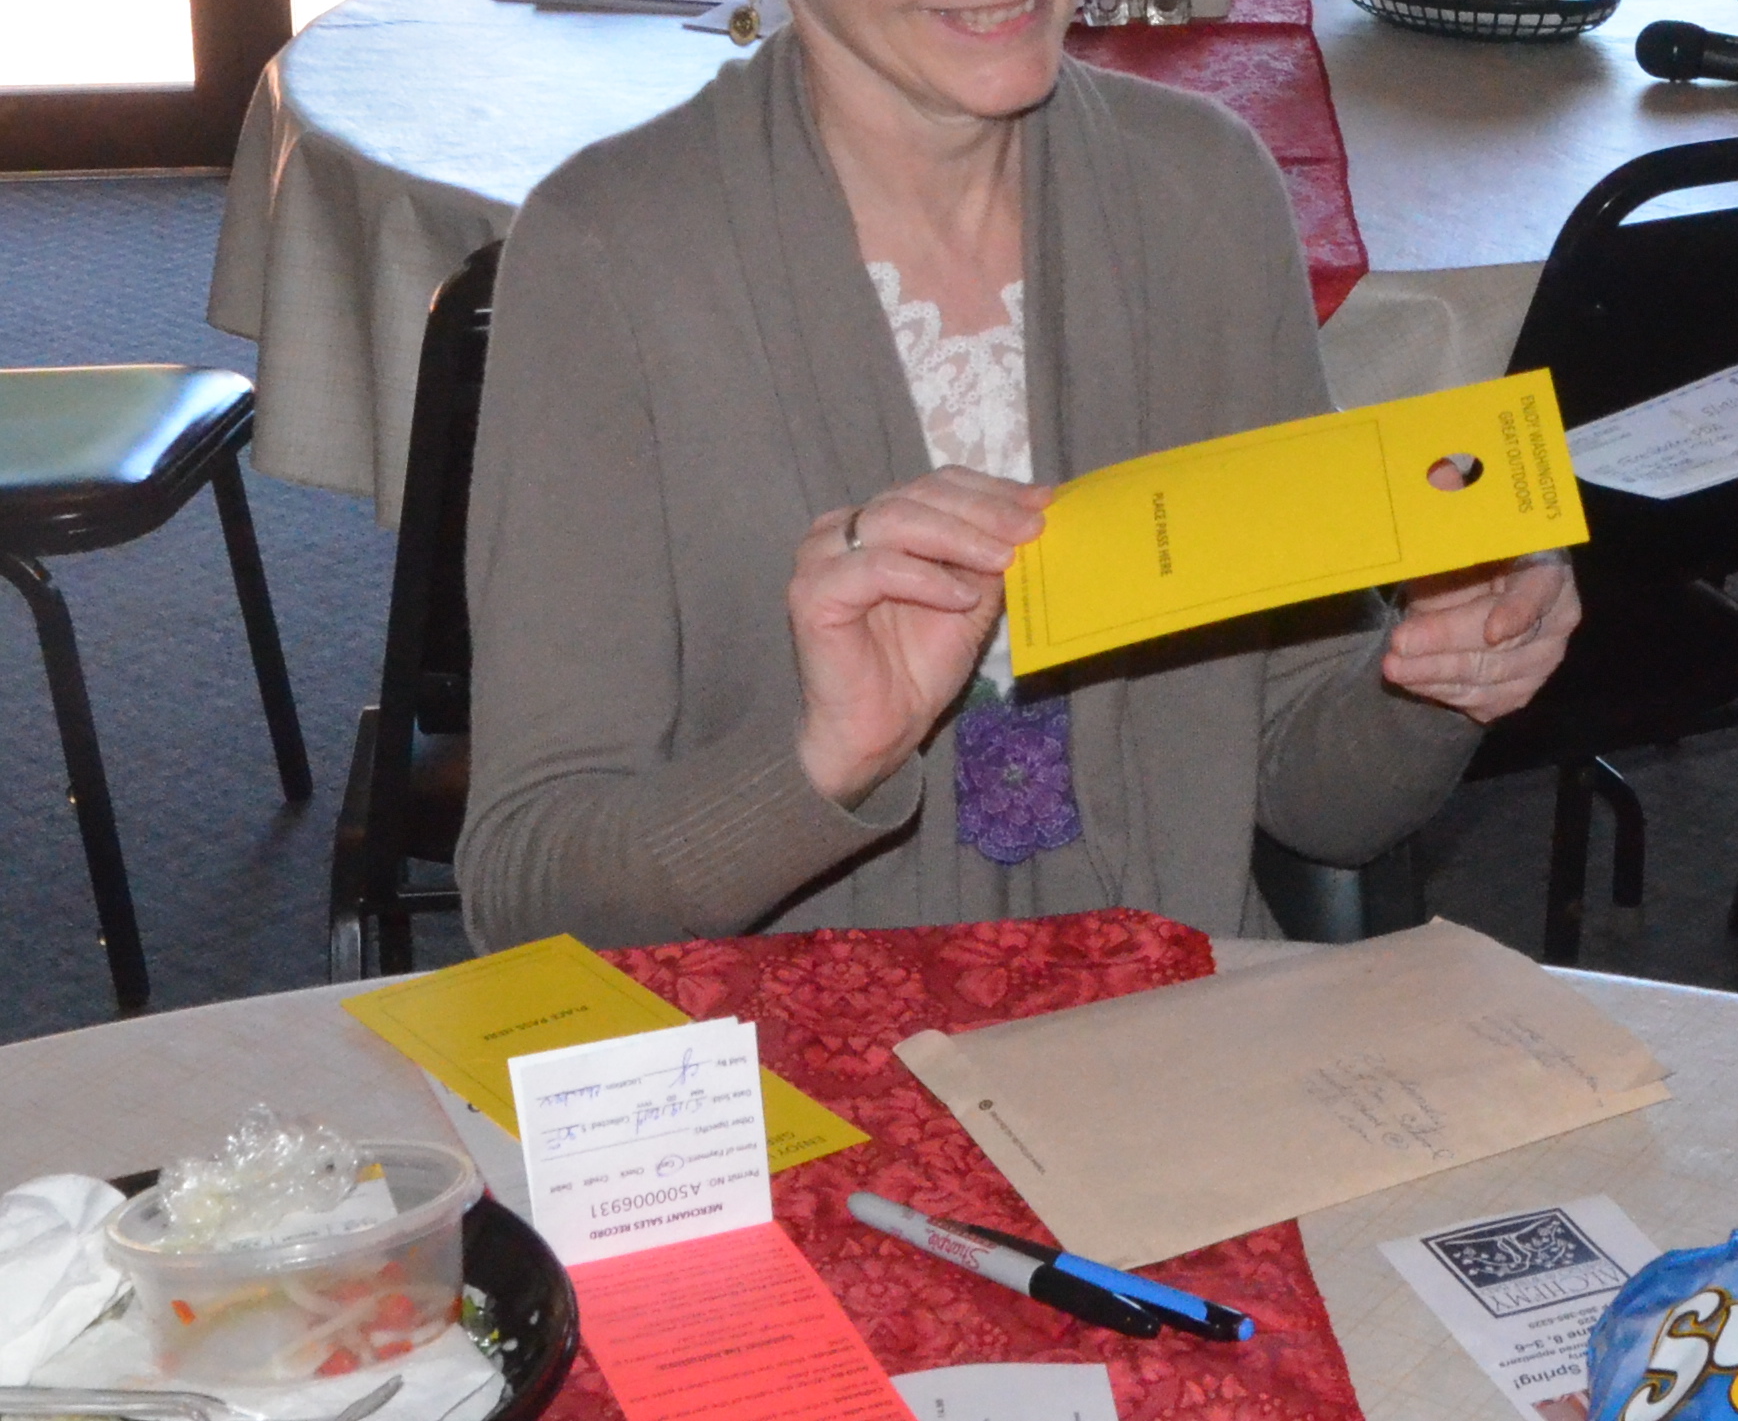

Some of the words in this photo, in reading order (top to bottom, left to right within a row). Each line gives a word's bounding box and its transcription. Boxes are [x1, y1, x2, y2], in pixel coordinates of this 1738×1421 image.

[1520, 394, 1541, 428] ENJOY
[1498, 410, 1520, 447] GREAT
[1506, 448, 1533, 514] OUTDOORS
[1529, 430, 1562, 521] WASHINGTON'S
[1152, 491, 1166, 521] PLACE
[1156, 522, 1170, 548] PASS
[1158, 549, 1174, 578] HERE
[738, 1143, 757, 1153] Form
[620, 1166, 645, 1178] Check
[729, 1170, 760, 1184] Permit
[590, 1182, 702, 1219] A500006931
[667, 1202, 724, 1223] MERCHANT
[589, 1221, 631, 1240] RECORD
[633, 1215, 664, 1230] SALES
[1487, 1266, 1625, 1313] ALCHEMY
[1512, 1363, 1583, 1391] Spring!
